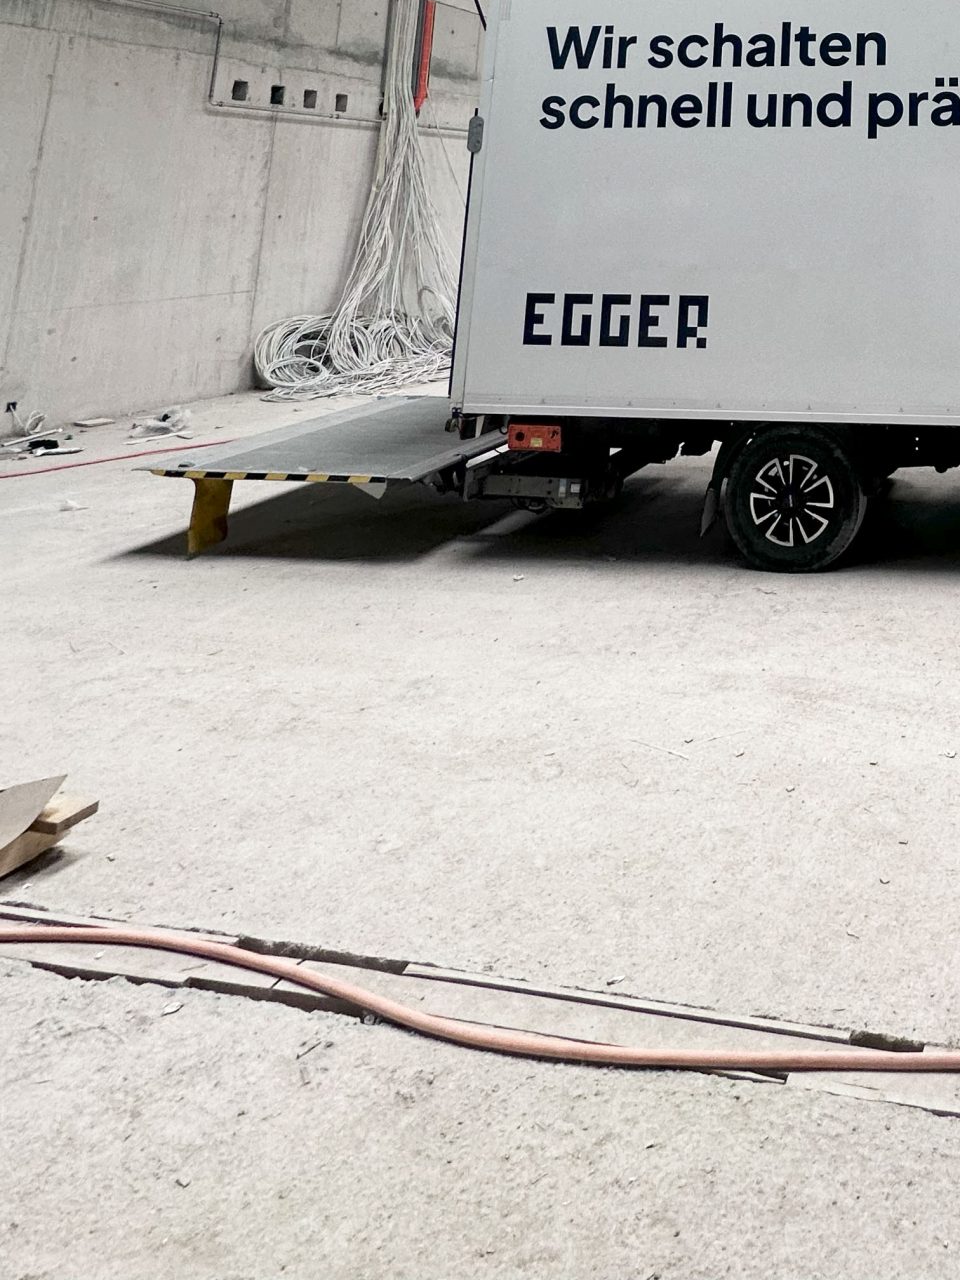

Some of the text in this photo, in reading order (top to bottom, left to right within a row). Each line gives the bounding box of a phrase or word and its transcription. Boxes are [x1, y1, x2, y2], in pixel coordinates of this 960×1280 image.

[547, 21, 887, 70] Wir schalten
[539, 81, 733, 130] schnell
[746, 81, 853, 128] und
[522, 292, 710, 349] EGGER
